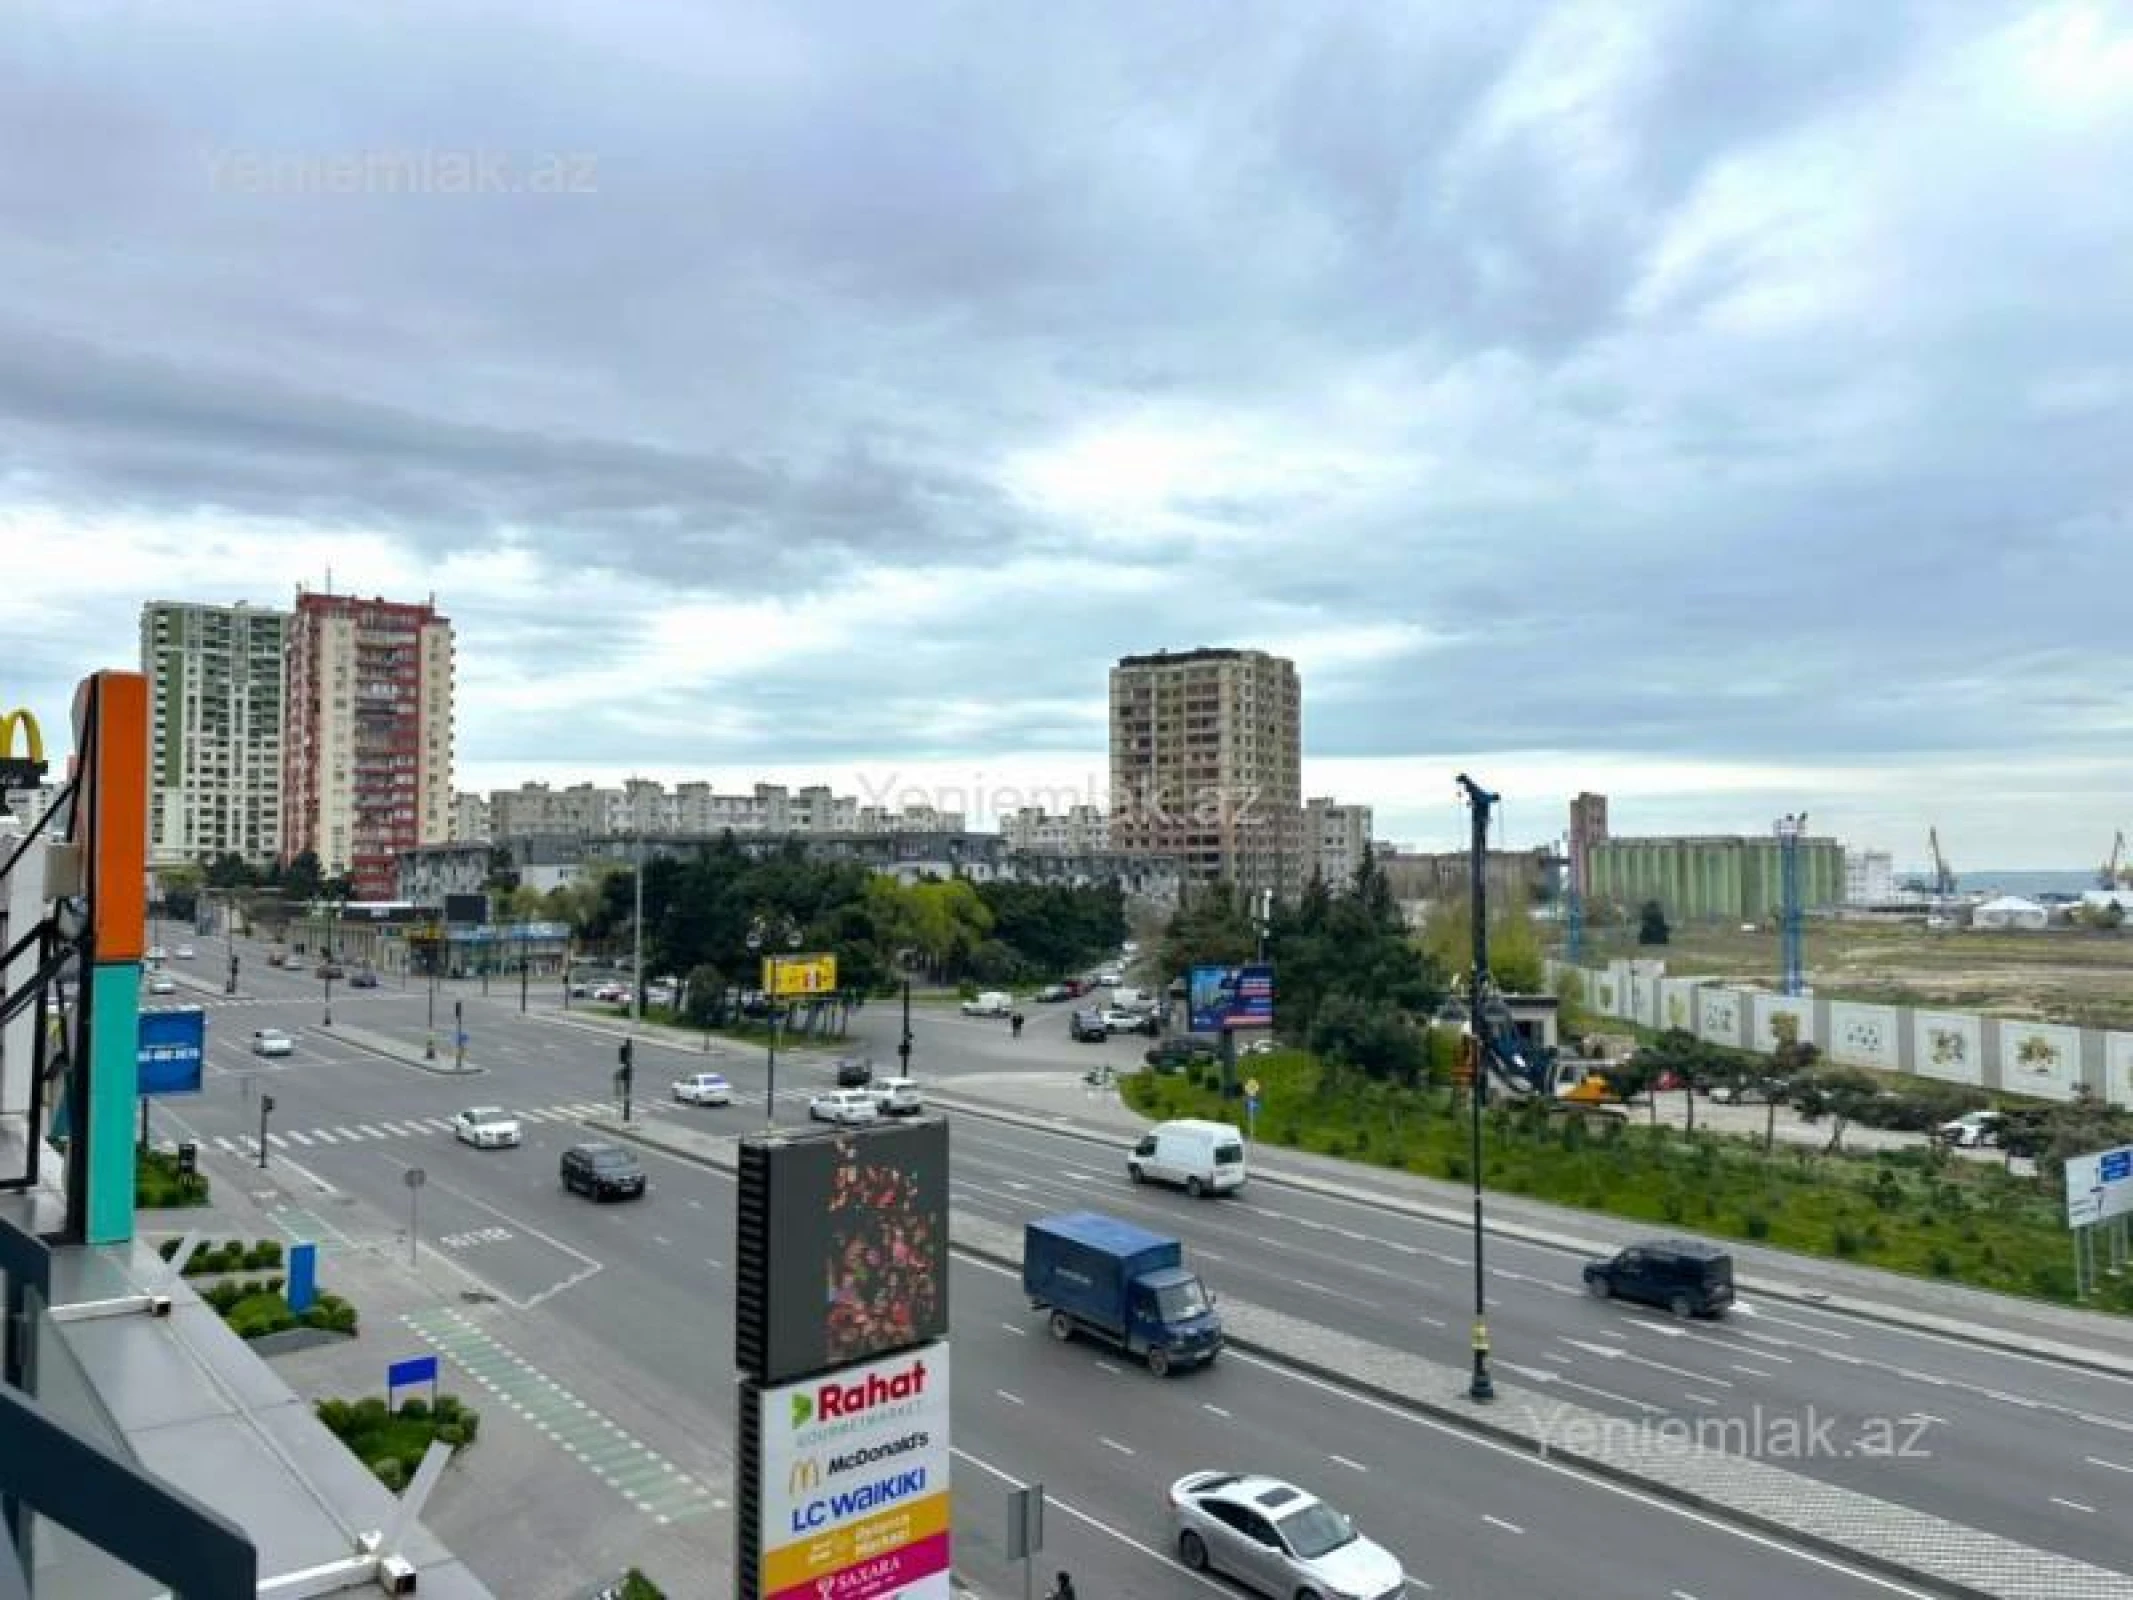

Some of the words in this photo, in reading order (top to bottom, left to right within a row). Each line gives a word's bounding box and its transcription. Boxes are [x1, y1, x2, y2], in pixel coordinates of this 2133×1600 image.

[818, 1360, 926, 1421] Rahat
[827, 1432, 929, 1475] McDonald's
[792, 1501, 825, 1531] LC
